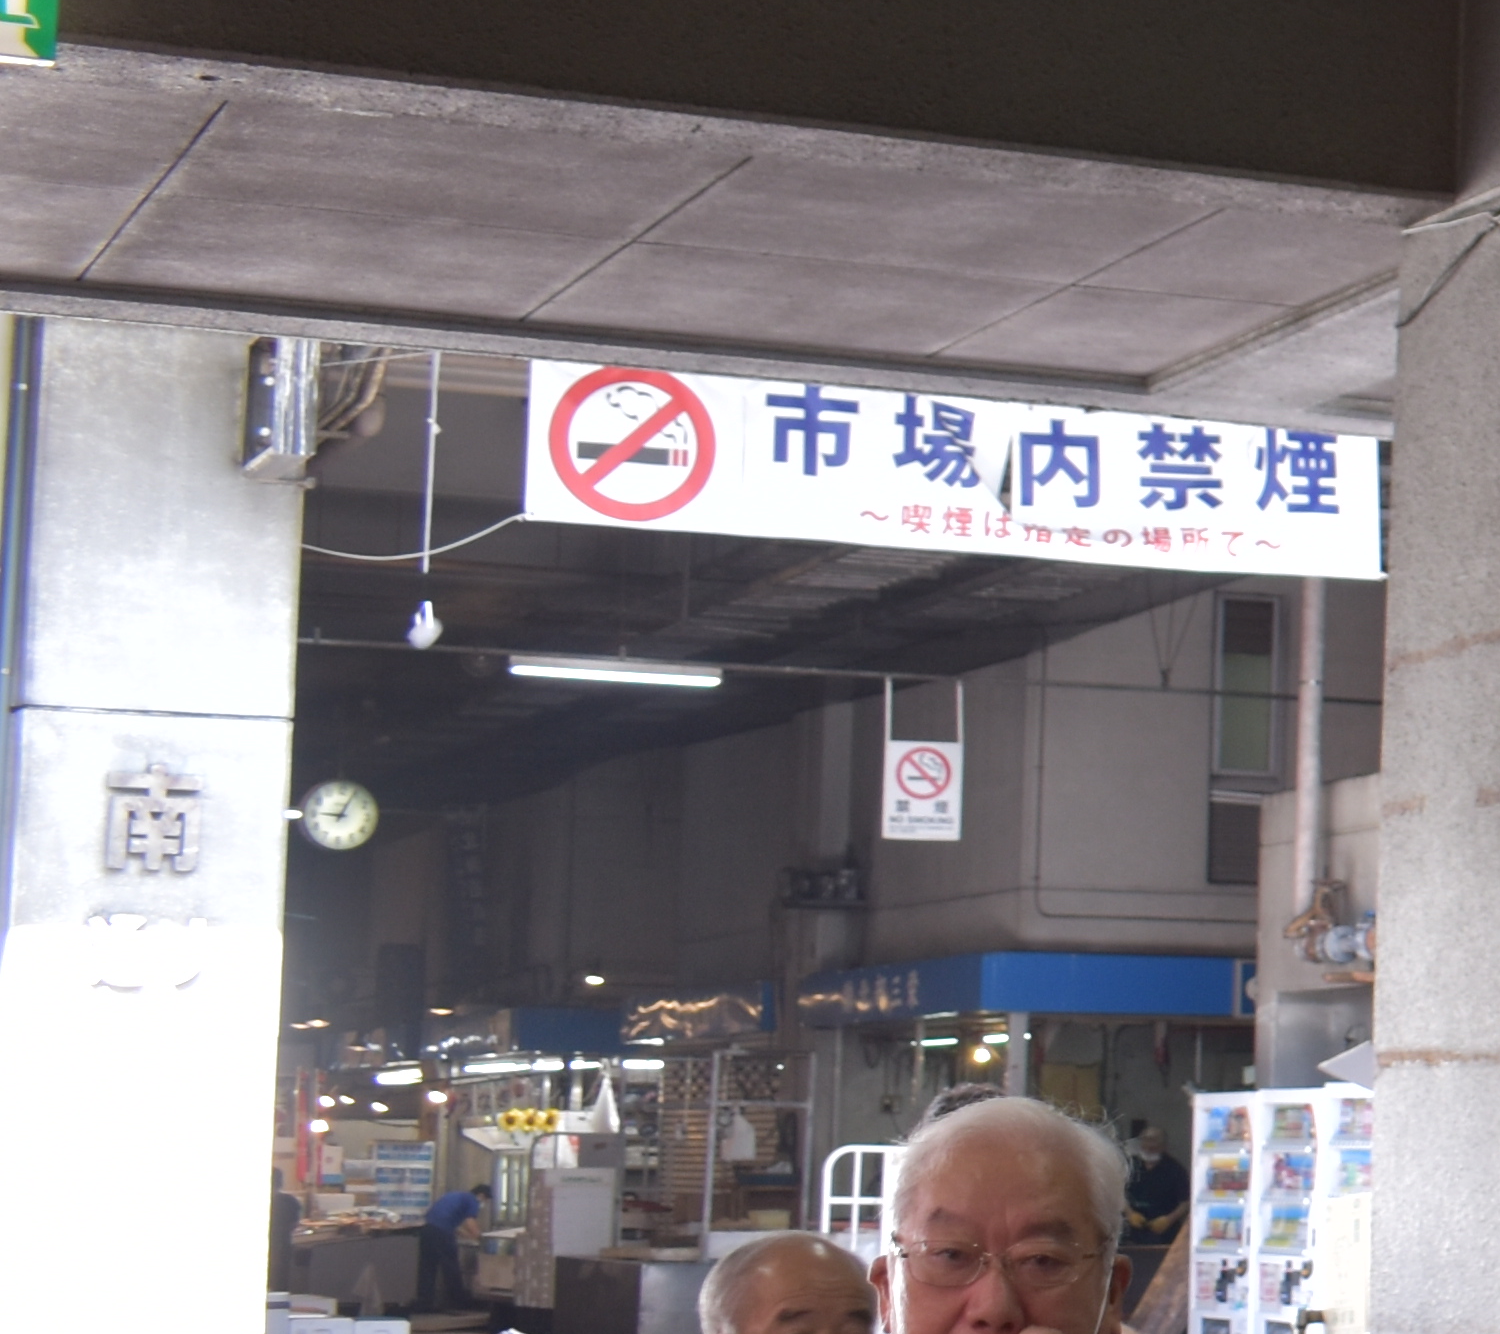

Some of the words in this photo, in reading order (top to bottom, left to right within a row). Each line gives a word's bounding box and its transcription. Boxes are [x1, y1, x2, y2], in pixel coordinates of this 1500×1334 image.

[765, 384, 1340, 514] 市場内禁煙
[107, 764, 201, 872] 南
